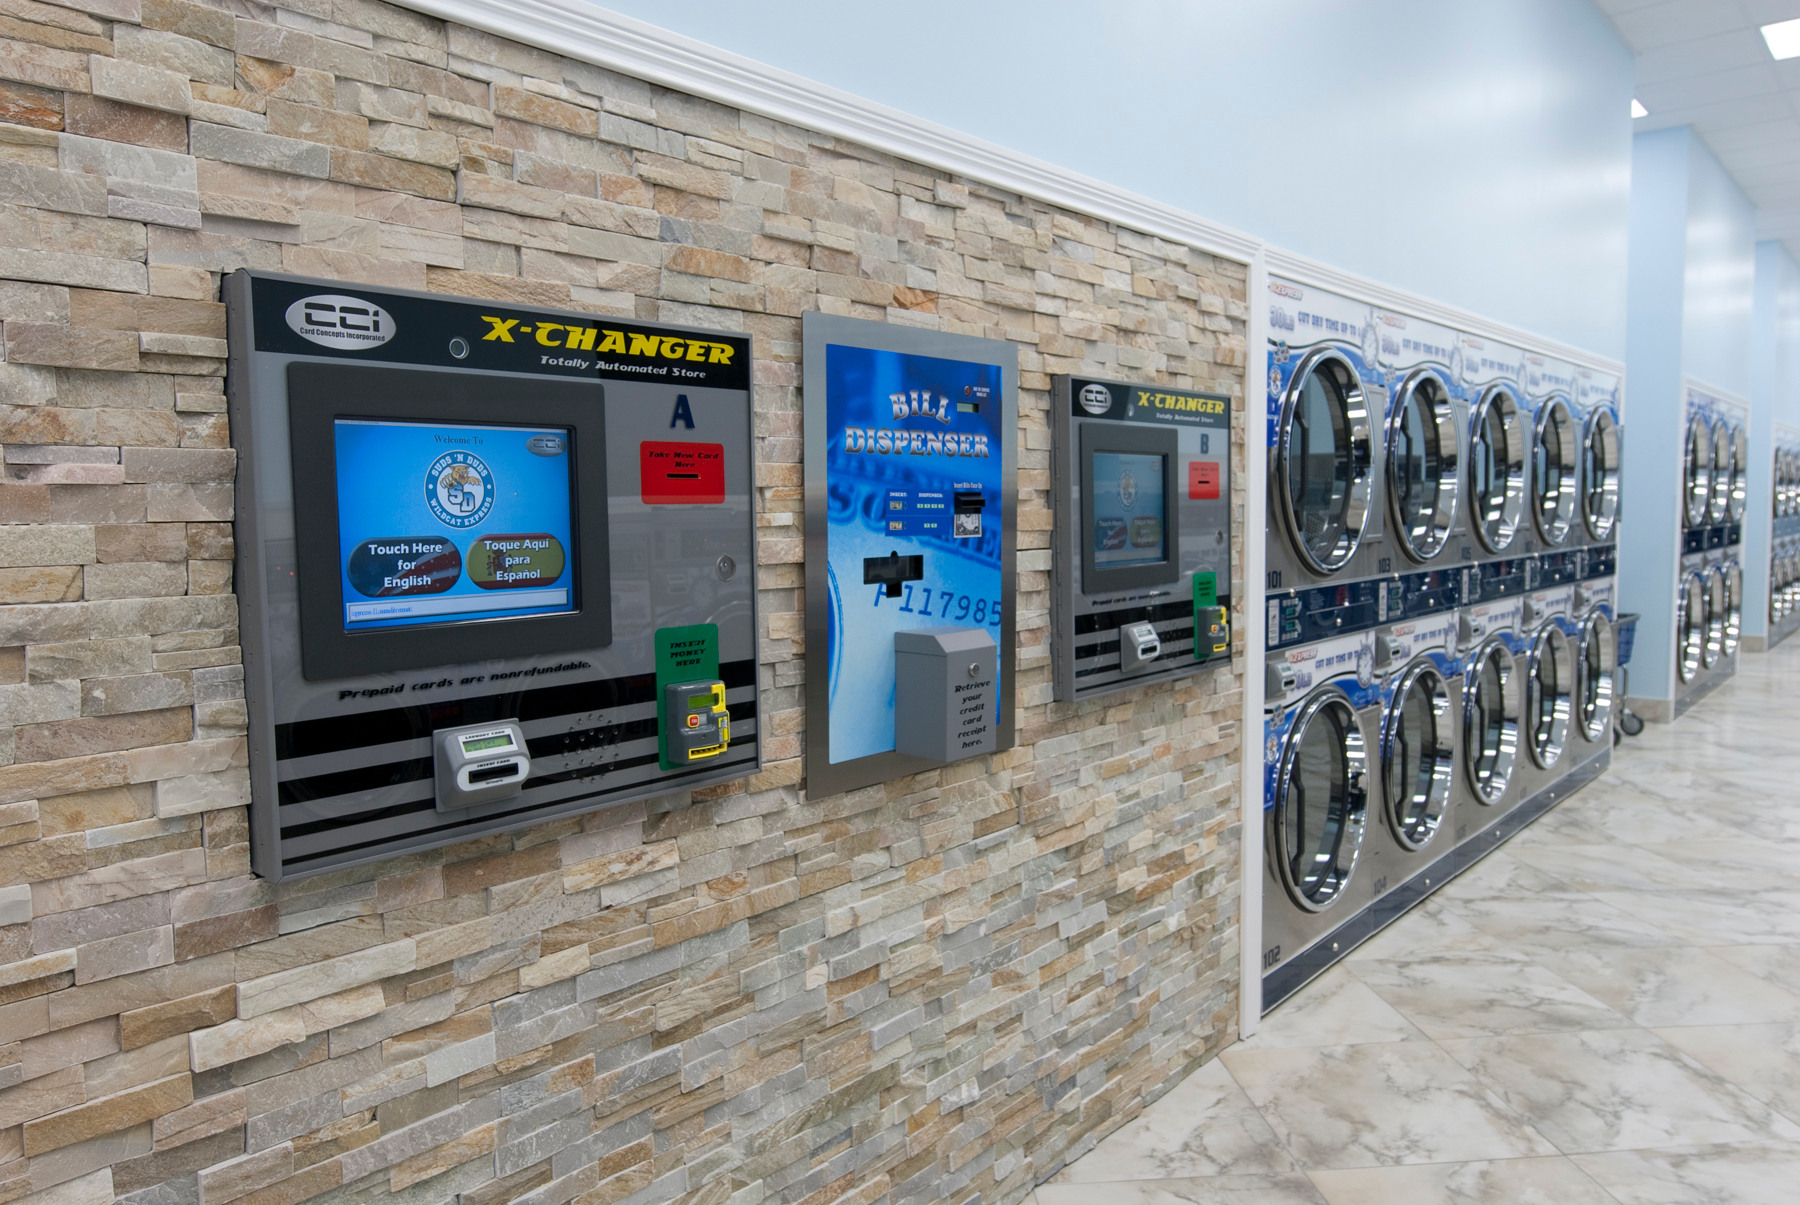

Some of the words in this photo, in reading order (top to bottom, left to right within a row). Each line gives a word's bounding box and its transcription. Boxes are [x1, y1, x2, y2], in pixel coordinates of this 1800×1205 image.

[1298, 311, 1310, 324] CUT
[1312, 314, 1323, 328] DRY
[1325, 318, 1339, 332] TIME
[300, 327, 315, 335] Card
[316, 329, 345, 338] Concepts
[347, 331, 385, 342] Incorporated
[481, 315, 735, 365] X-CHANGER
[541, 355, 589, 369] Totally
[595, 361, 667, 375] Automated
[672, 367, 706, 379] Store
[889, 389, 951, 425] BILL
[1137, 391, 1225, 415] X-CHANGER
[670, 394, 695, 430] A
[434, 435, 470, 445] Welcome
[472, 436, 483, 445] To
[844, 426, 989, 458] DISPENSER
[1200, 433, 1210, 454] B
[431, 456, 452, 477] SUDS
[454, 453, 464, 462] 'N
[466, 455, 488, 477] DUDS
[430, 497, 462, 526] WILDCAT
[465, 497, 492, 526] EXPRESS
[369, 543, 410, 555] Touch
[412, 543, 443, 554] Here
[484, 540, 521, 551] Toque
[523, 538, 549, 551] Aquí
[397, 559, 416, 570] for
[505, 556, 531, 567] para
[496, 569, 540, 582] Español
[1267, 571, 1282, 589] 101
[384, 576, 432, 589] English
[670, 639, 706, 649] INSERT
[670, 648, 706, 658] MONEY
[675, 658, 701, 667] HERE
[338, 684, 406, 700] Prepaid
[412, 678, 453, 691] cards
[459, 675, 485, 685] are
[490, 660, 592, 681] nonrefundable.
[955, 680, 991, 693] Retrieve
[962, 693, 982, 704] your
[960, 703, 985, 715] credit
[963, 714, 982, 726] card
[958, 725, 986, 739] receipt
[962, 739, 982, 749] here.
[1263, 945, 1280, 970] 102
